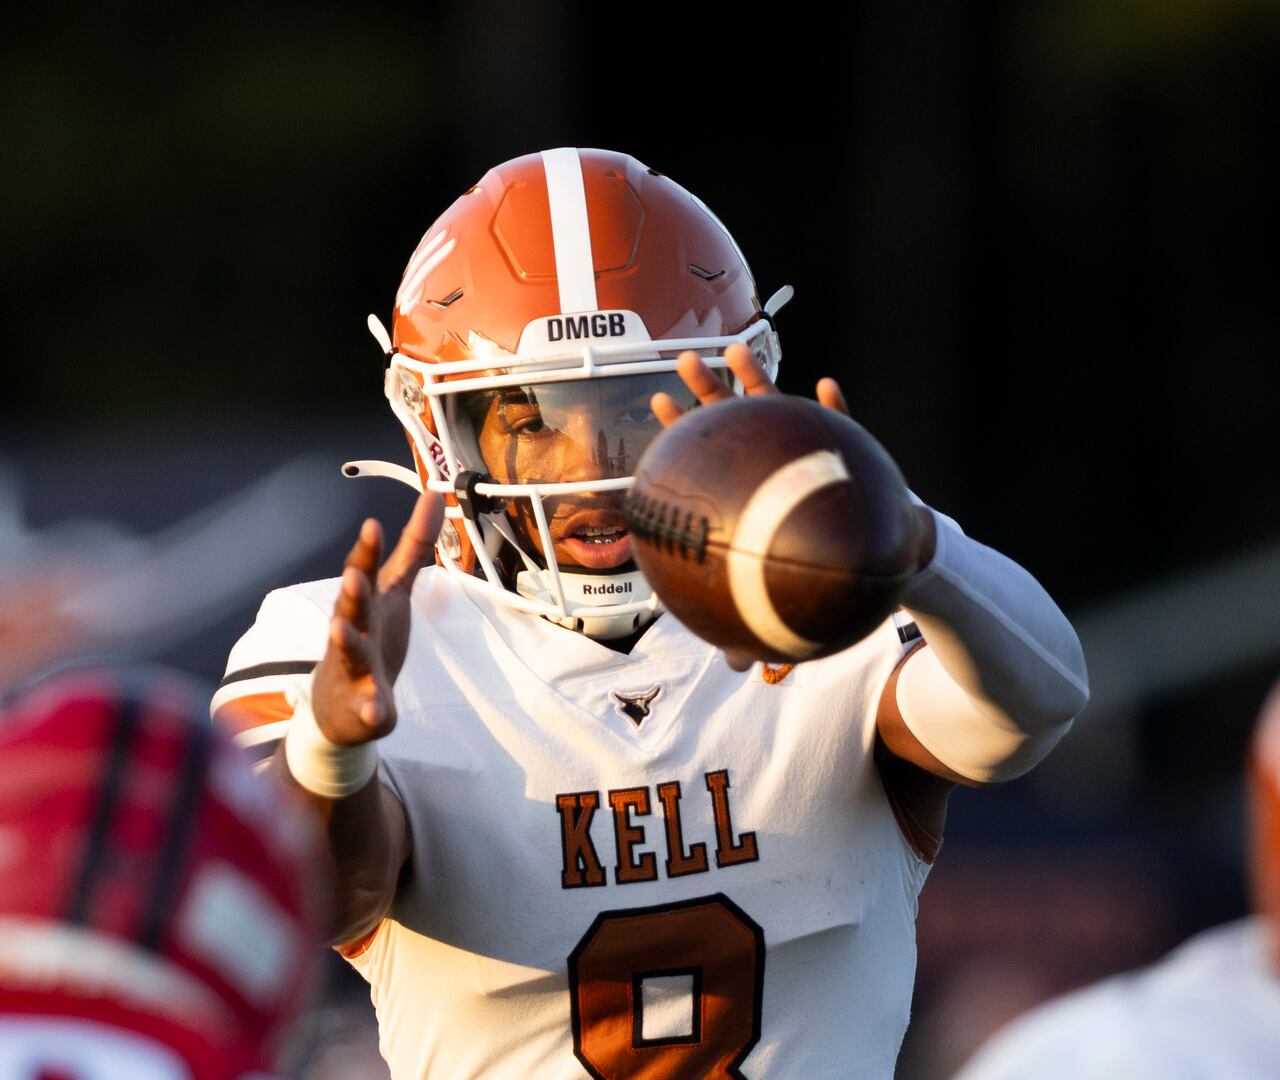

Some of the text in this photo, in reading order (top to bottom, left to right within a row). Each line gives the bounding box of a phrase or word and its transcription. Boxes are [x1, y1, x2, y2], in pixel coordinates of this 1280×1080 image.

[547, 313, 625, 341] DMGB
[583, 582, 632, 594] Riddell
[556, 769, 759, 888] KELL
